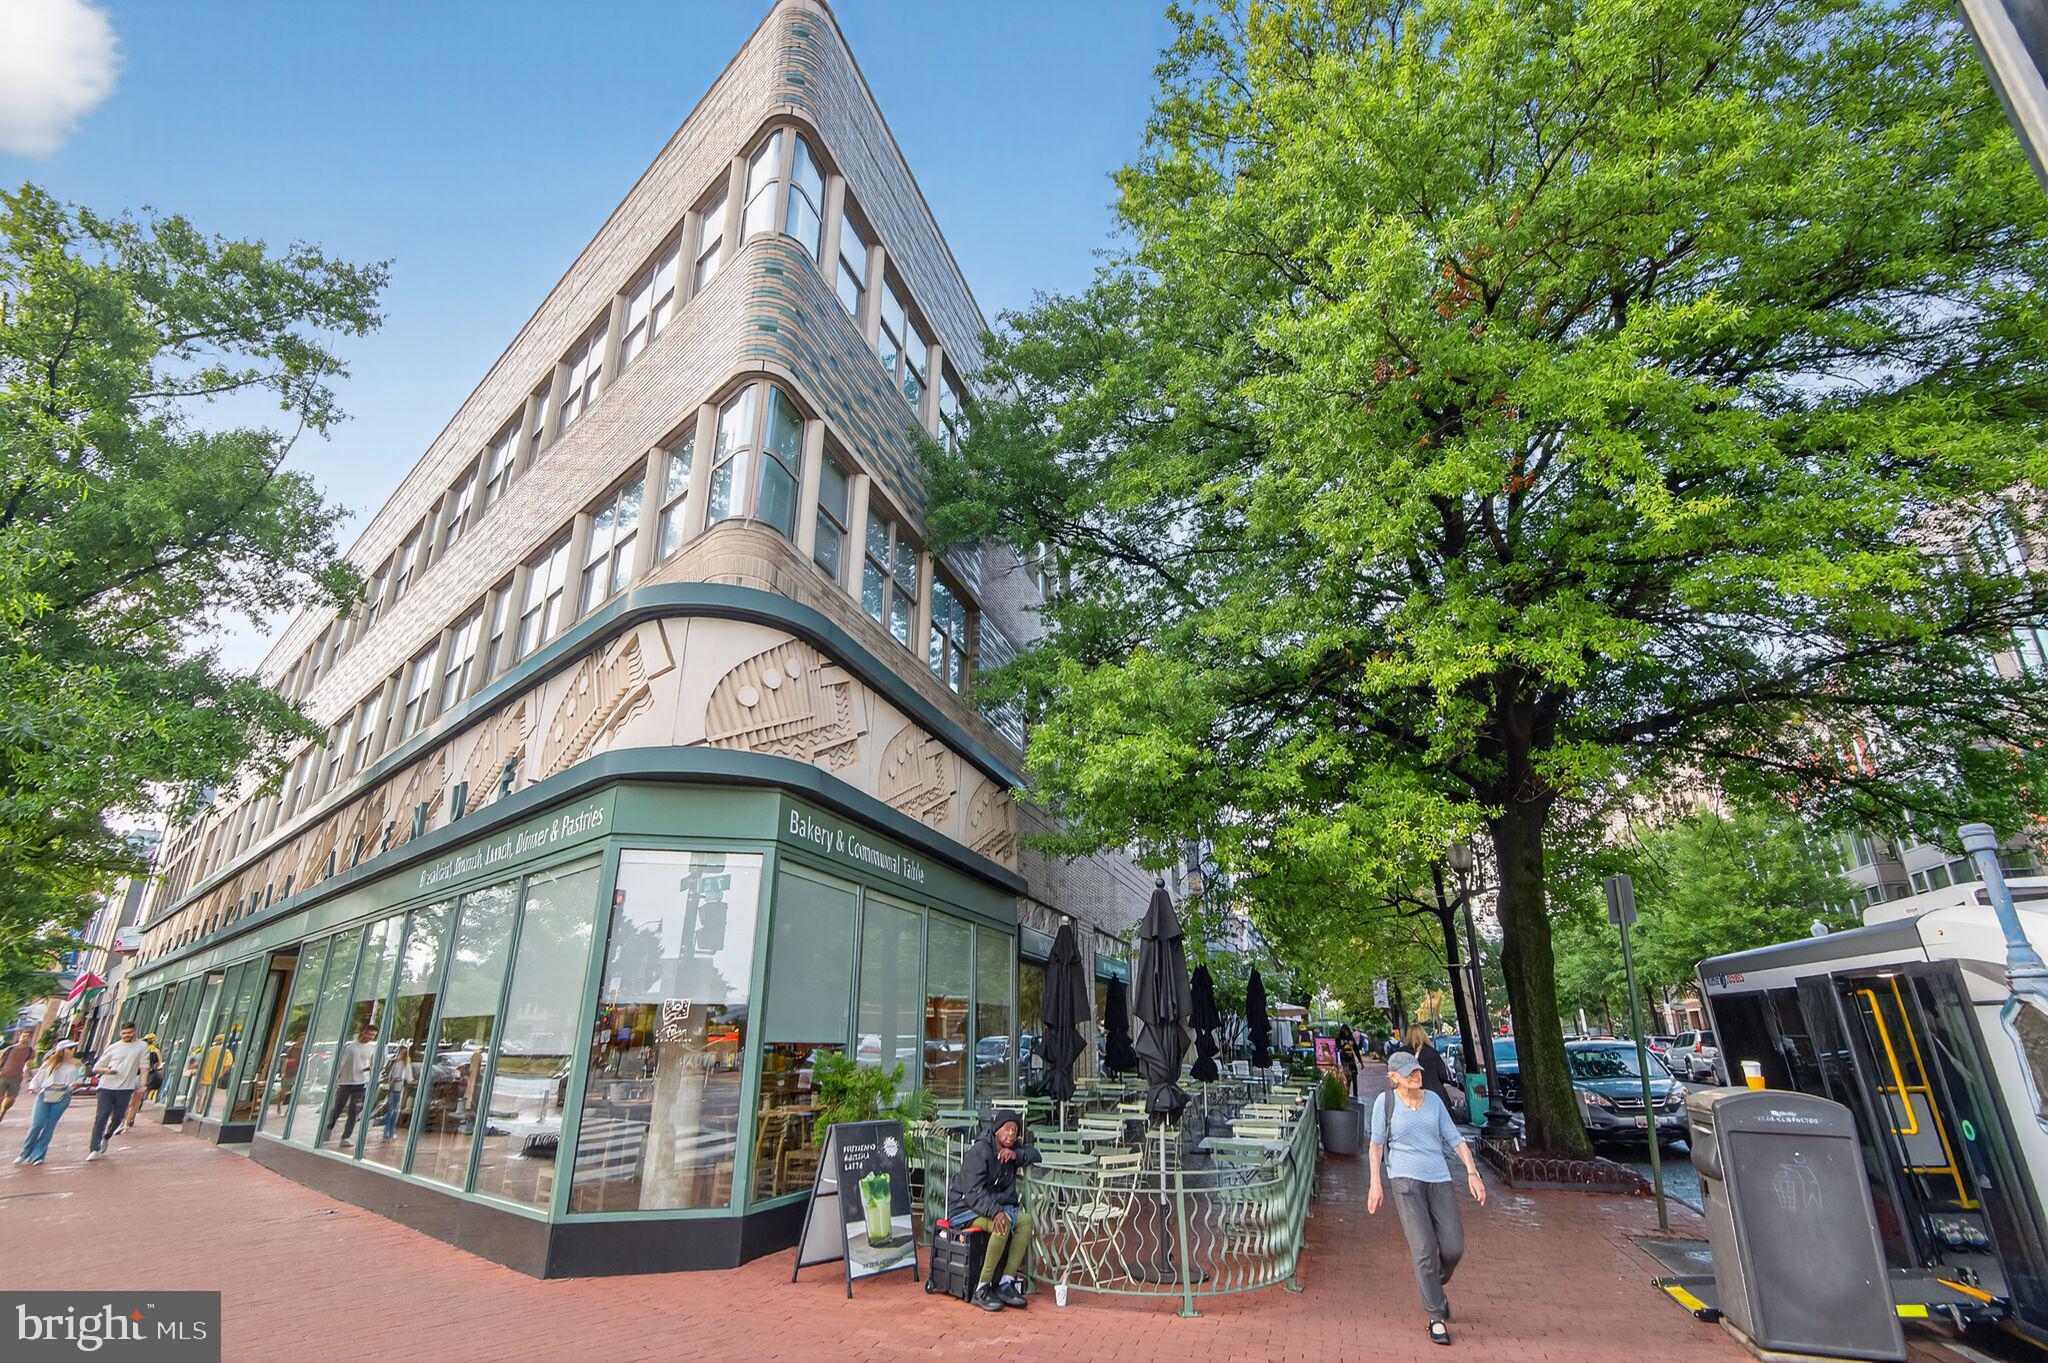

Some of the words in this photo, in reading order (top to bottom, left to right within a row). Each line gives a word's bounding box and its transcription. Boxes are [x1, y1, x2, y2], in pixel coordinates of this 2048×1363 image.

[485, 837, 514, 866] Lunch,
[516, 827, 550, 855] Dinner
[550, 817, 559, 842] &
[561, 804, 604, 840] Pastries
[789, 809, 833, 853] Bakery
[836, 829, 845, 853] &
[848, 835, 900, 875] Communal
[902, 856, 925, 884] Table
